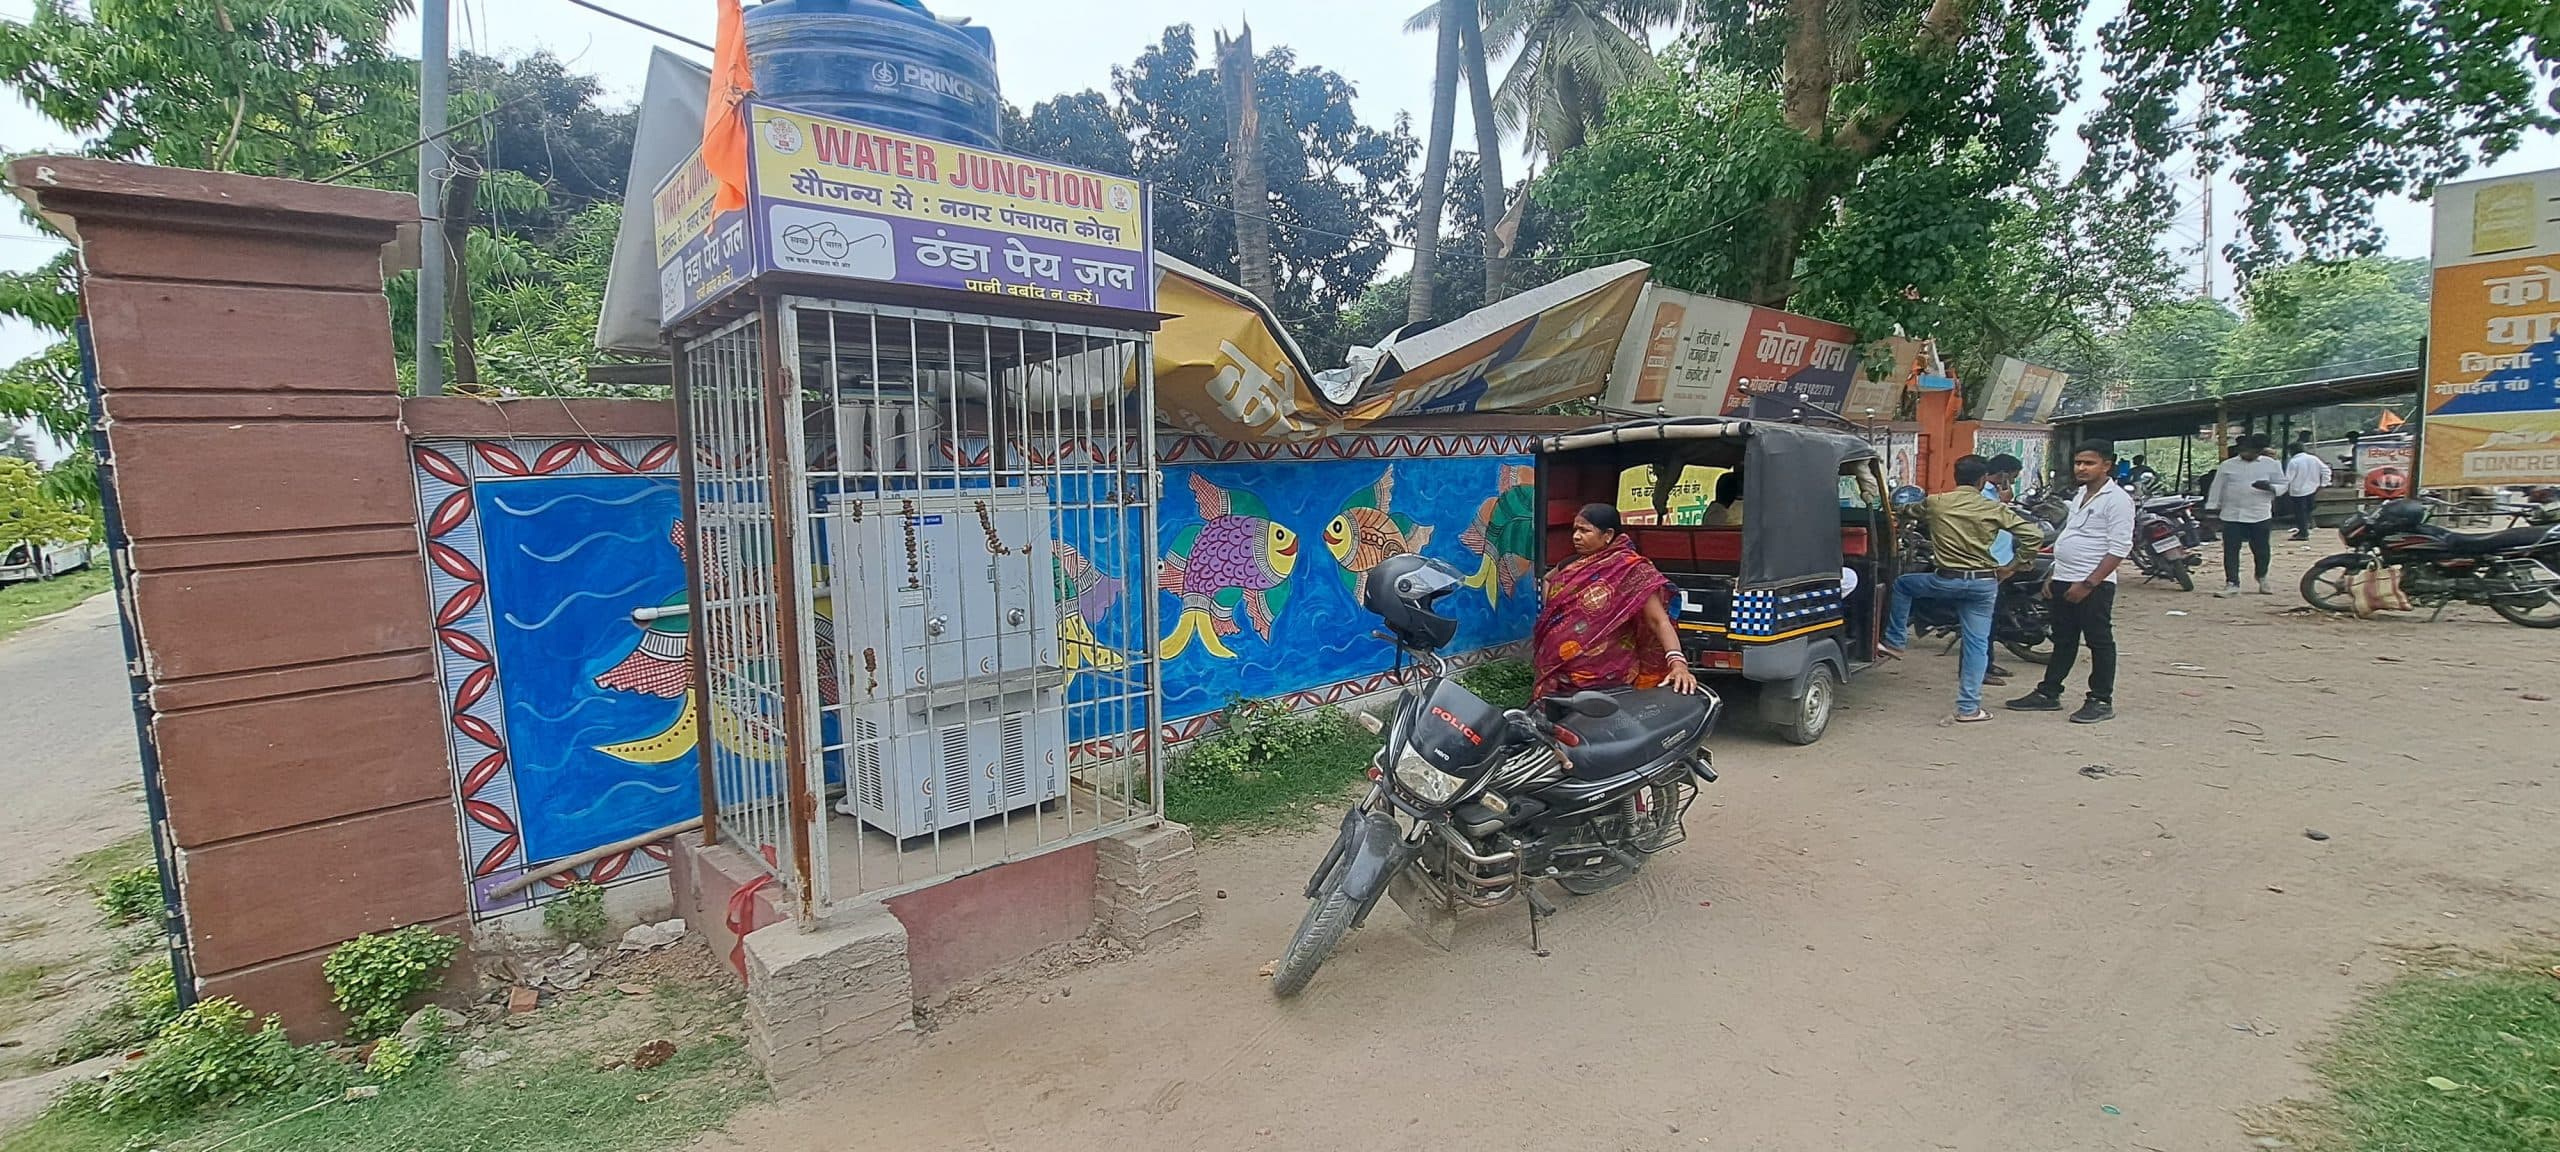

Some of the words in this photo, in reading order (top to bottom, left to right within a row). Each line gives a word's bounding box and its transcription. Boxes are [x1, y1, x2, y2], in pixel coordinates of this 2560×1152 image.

[903, 63, 974, 102] PRINCE
[811, 123, 938, 183] WATER
[949, 152, 1104, 212] JUNCTION
[790, 168, 883, 206] सौजन्य
[890, 183, 914, 211] से
[938, 198, 992, 222] नगर
[999, 203, 1068, 235] पंचायत
[1073, 215, 1121, 245] कोढ़ा
[721, 218, 744, 261] जल
[912, 228, 991, 274] ठंडा
[1003, 237, 1061, 282] पेय
[1072, 257, 1135, 290] जल
[965, 278, 1001, 295] पानी
[1007, 282, 1046, 299] बर्बाद
[1050, 289, 1063, 301] न
[1810, 338, 1852, 371] थाना
[2472, 455, 2560, 472] CONCRE
[1431, 706, 1482, 746] POLICE
